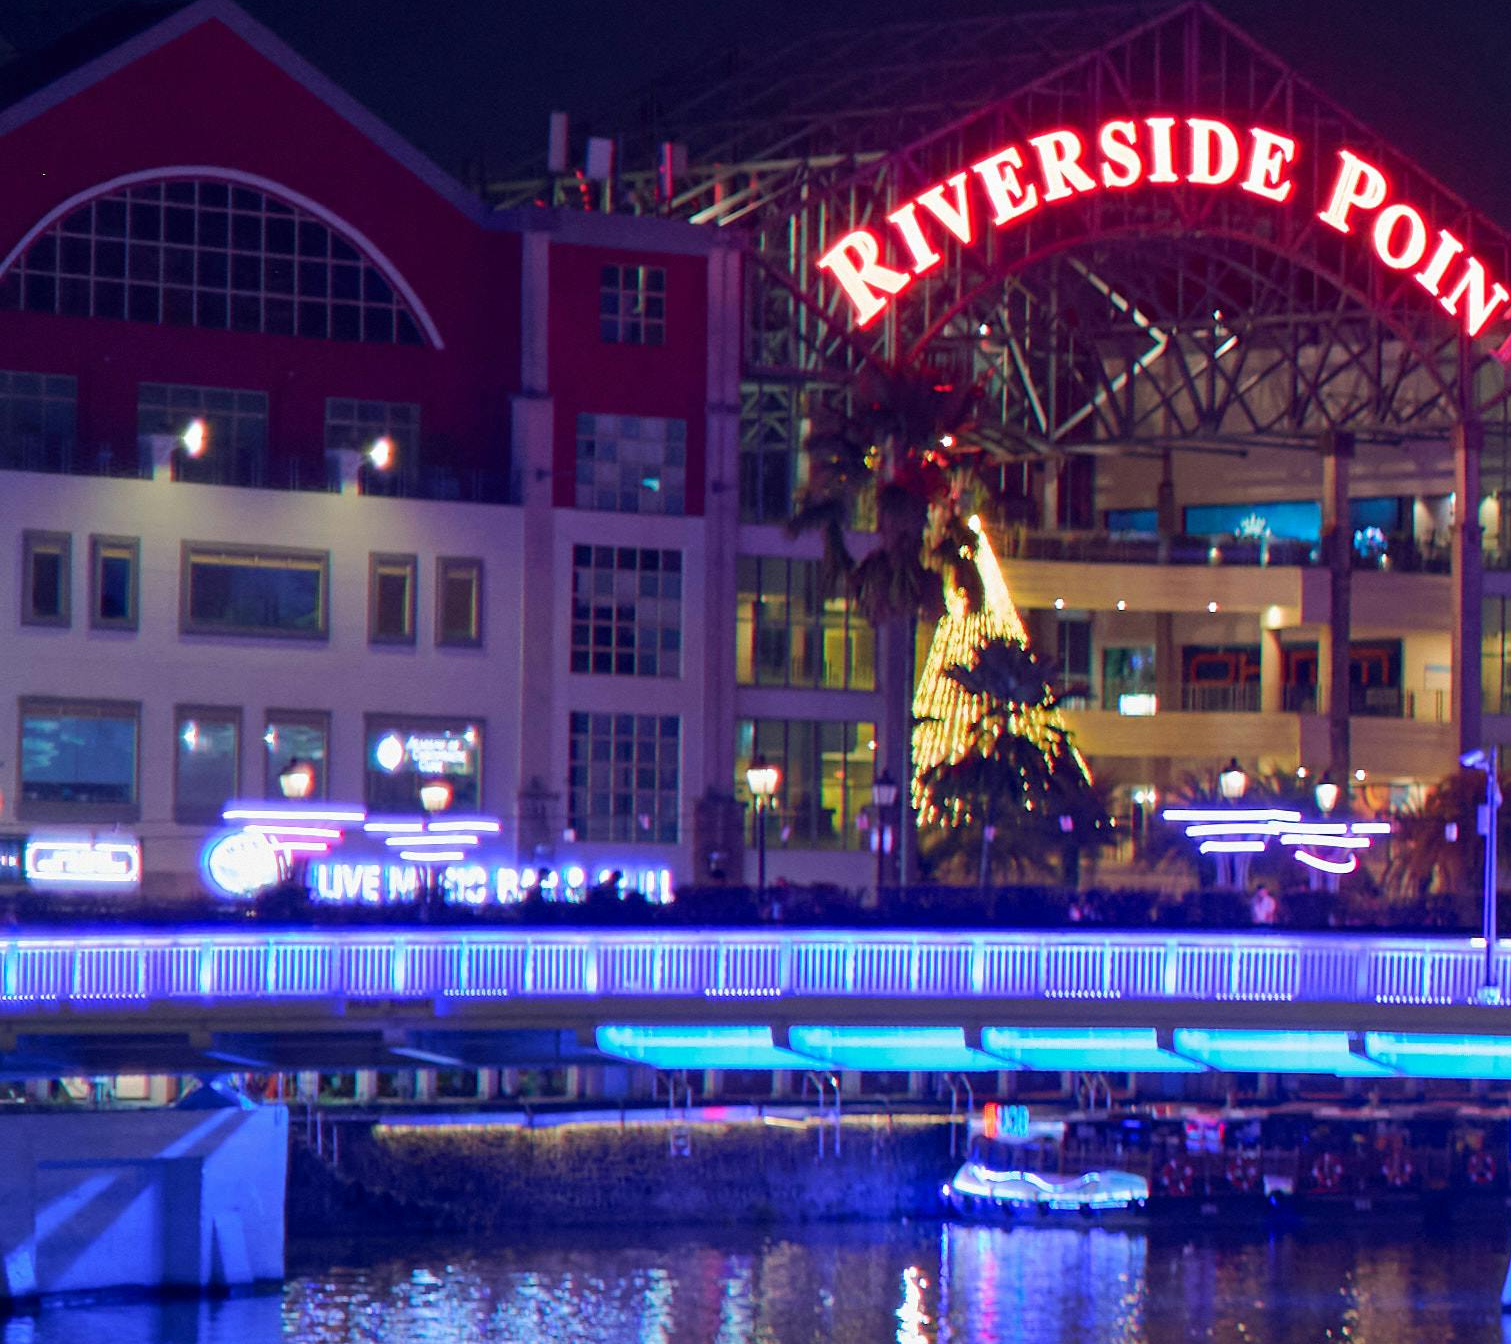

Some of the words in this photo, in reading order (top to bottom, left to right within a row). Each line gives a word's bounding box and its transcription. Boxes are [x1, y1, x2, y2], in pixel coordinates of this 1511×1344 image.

[818, 116, 1297, 328] RIVERSIDE
[318, 864, 380, 901] LIVE
[387, 865, 487, 904] MSIC
